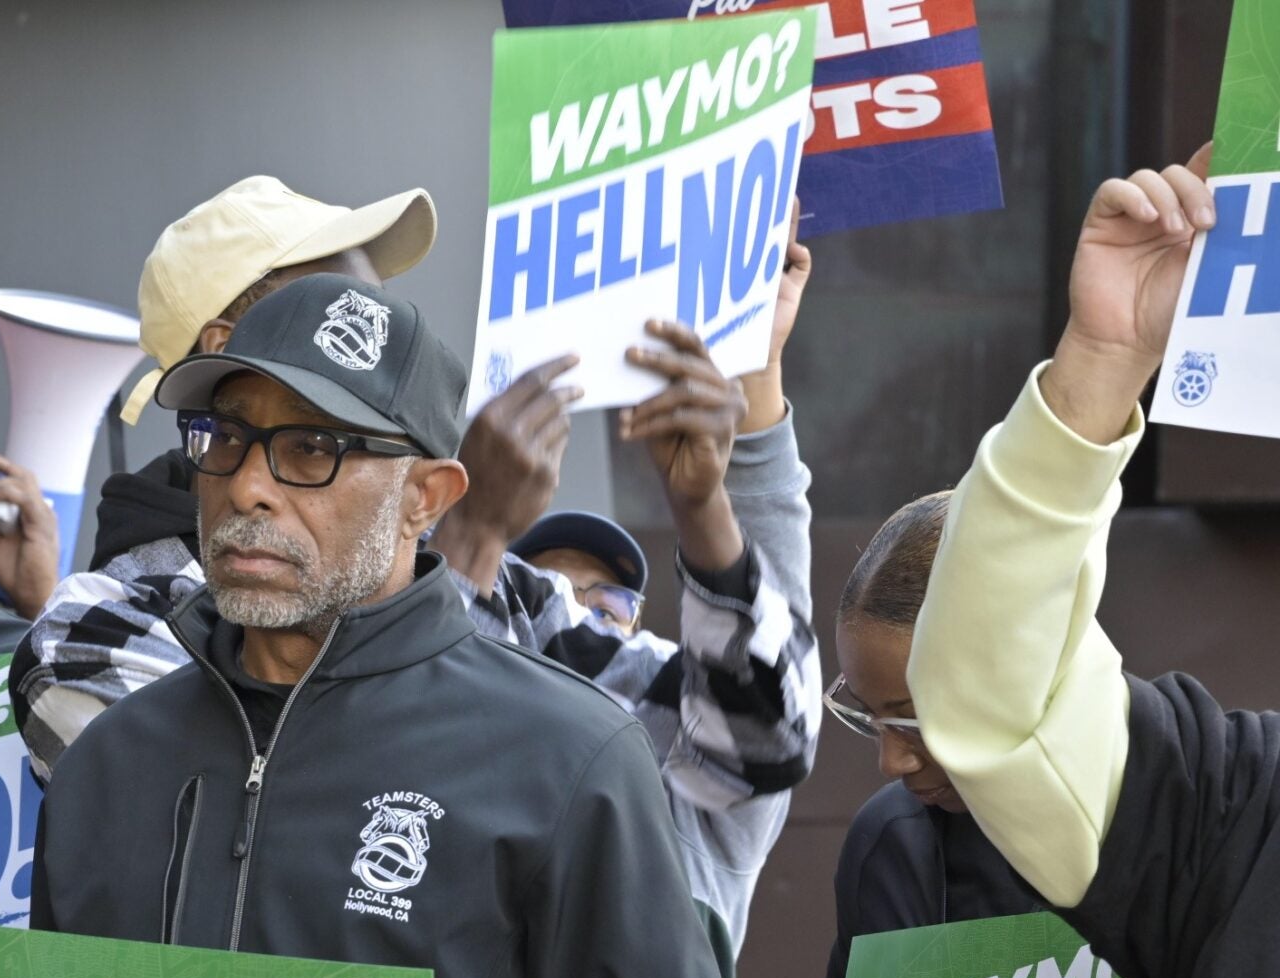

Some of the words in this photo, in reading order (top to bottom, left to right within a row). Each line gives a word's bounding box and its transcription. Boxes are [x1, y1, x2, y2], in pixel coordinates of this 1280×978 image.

[530, 18, 801, 184] WAYMO?
[488, 165, 677, 324] HELL
[676, 119, 801, 331] NO!
[362, 791, 445, 820] TEAMSTERS
[344, 899, 393, 920] Hollywood,
[394, 910, 409, 922] CA
[348, 887, 389, 904] LOCAL
[390, 896, 412, 910] 399
